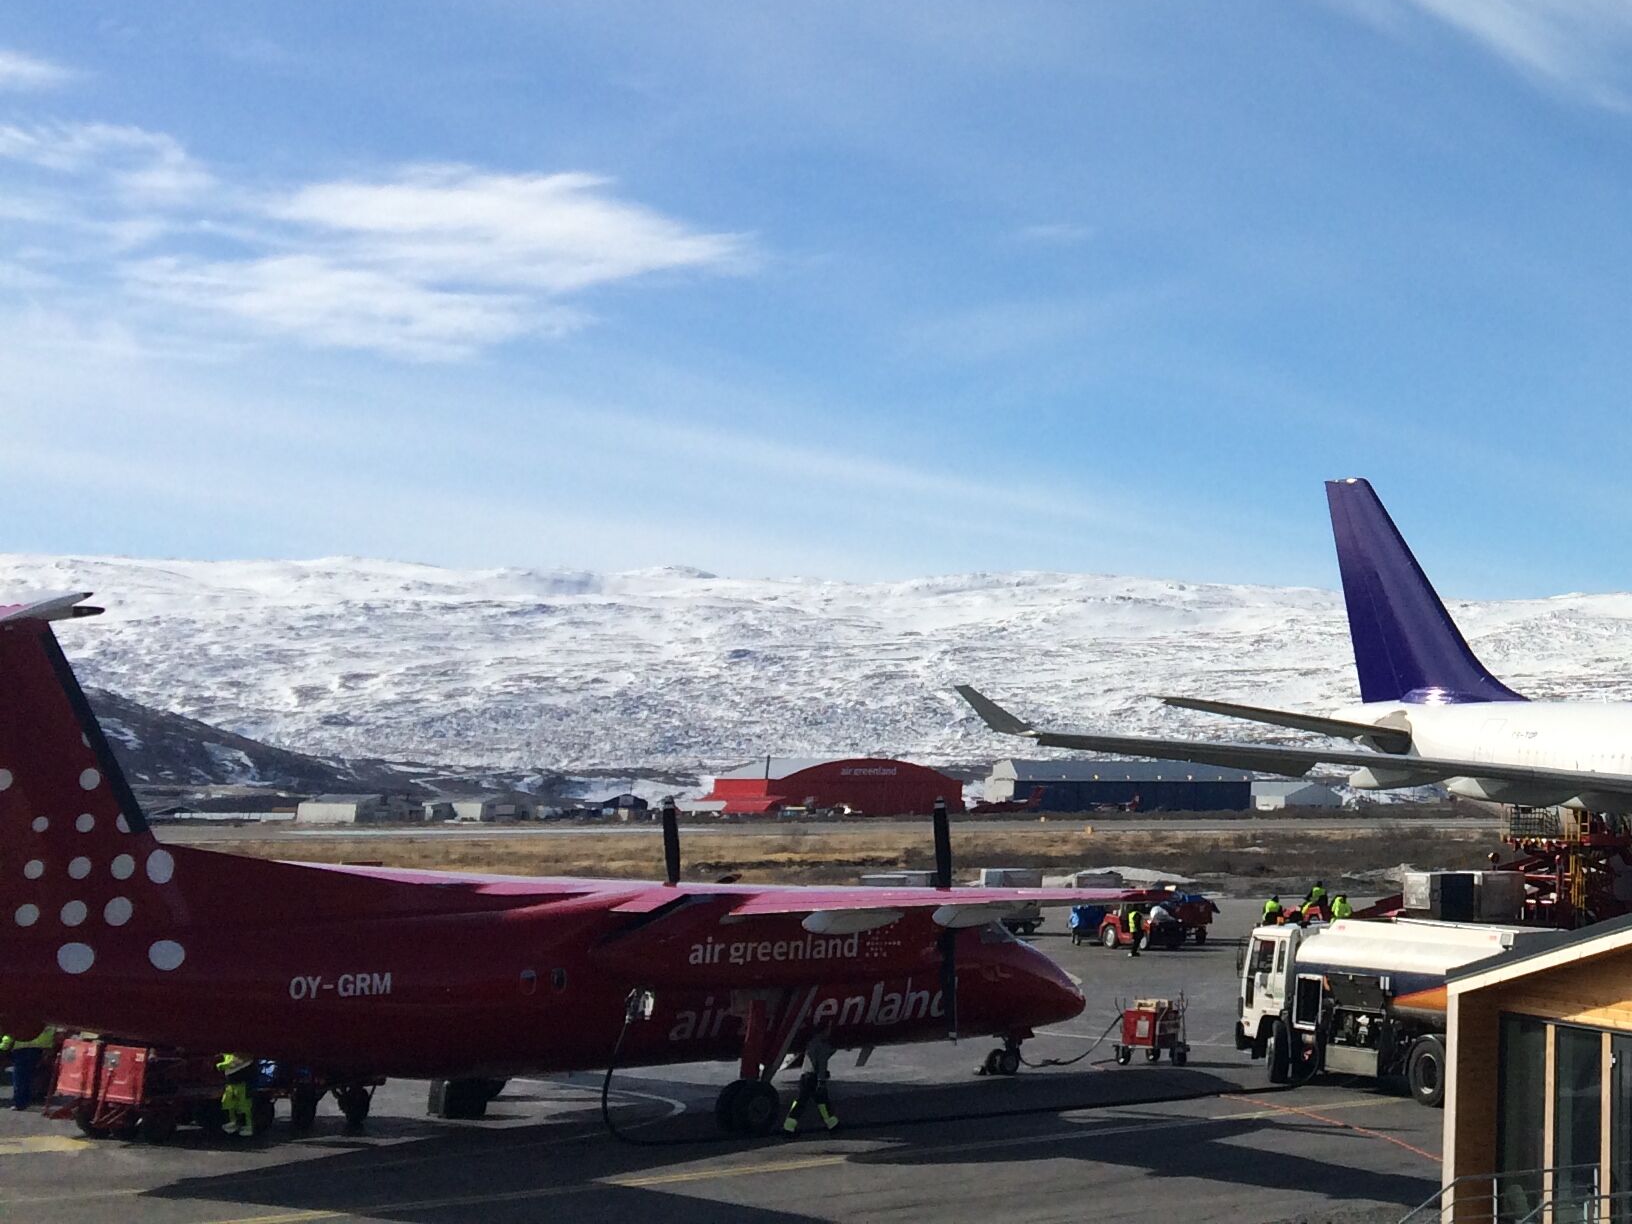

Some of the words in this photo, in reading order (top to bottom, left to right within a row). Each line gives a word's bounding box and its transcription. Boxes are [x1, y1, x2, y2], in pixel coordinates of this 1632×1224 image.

[688, 936, 725, 965] air
[728, 932, 859, 965] greenland
[289, 972, 392, 1000] OY-GRM
